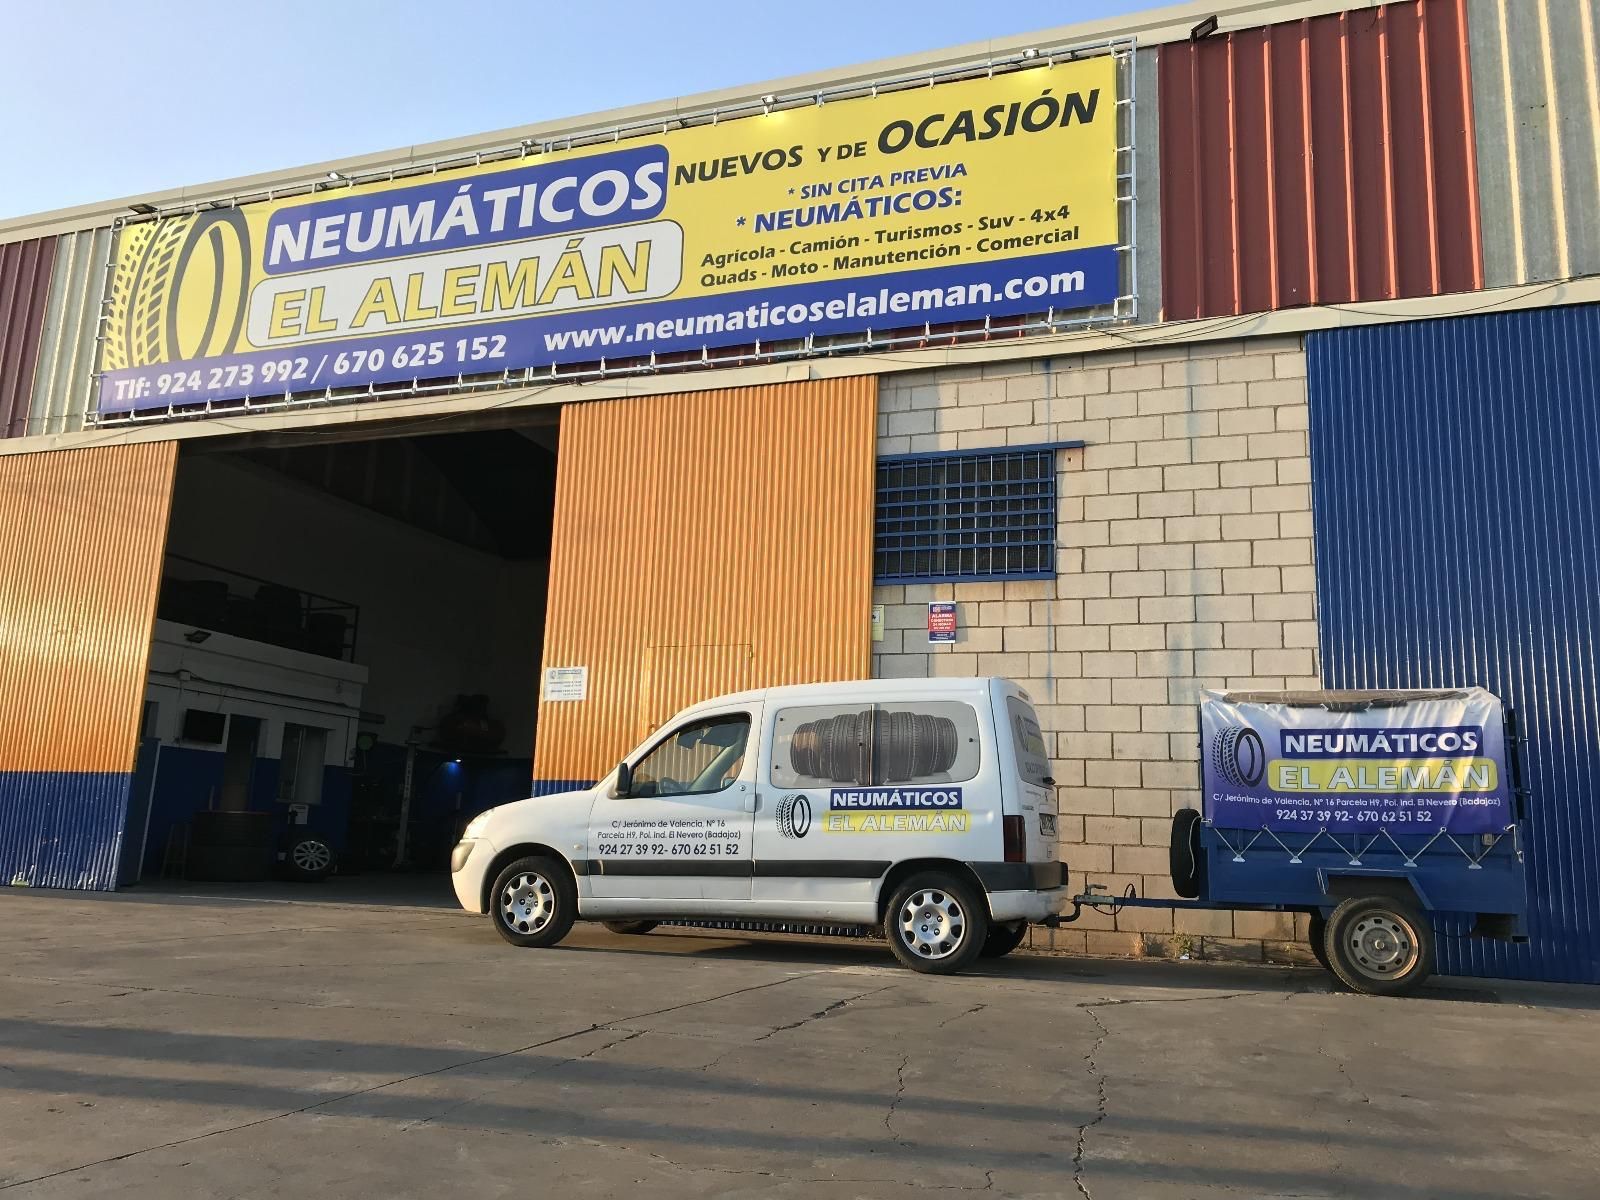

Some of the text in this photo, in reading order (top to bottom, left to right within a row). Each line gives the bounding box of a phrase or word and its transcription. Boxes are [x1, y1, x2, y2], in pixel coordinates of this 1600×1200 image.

[674, 87, 1101, 186] NUEVOS Y DE OCASIÓN
[801, 163, 967, 199] SIN CITA PREVIA
[269, 160, 664, 266] NEUMÁTICOS
[754, 186, 962, 233] NEUMÁTICOS:
[701, 245, 775, 268] Agrícola
[790, 235, 859, 255] Camión
[874, 221, 962, 244] Turismos
[978, 216, 1014, 231] Suv
[1030, 205, 1070, 223] 4x4
[701, 269, 757, 287] Quads
[771, 262, 818, 278] Moto
[833, 244, 960, 270] Manutención
[976, 226, 1079, 253] Comercial
[268, 238, 653, 340] EL ALEMÁN
[544, 270, 1085, 352] www.neumaticoselaleman.com
[115, 376, 151, 400] Tlf:
[157, 370, 201, 395] 924
[208, 364, 254, 390] 273
[261, 357, 309, 383] 992
[334, 348, 385, 375] 670
[392, 341, 445, 369] 625
[456, 335, 507, 362] 152
[1285, 730, 1478, 753] NEUMÁTICOS
[1278, 759, 1490, 790] EL ALEMÁN
[833, 789, 958, 807] NEUMÁTICOS
[1225, 794, 1260, 804] Jerónimo
[1325, 798, 1335, 806] 16
[1337, 798, 1367, 806] Parcela
[1417, 798, 1425, 806] El
[1426, 798, 1457, 806] Nevero
[1460, 797, 1501, 807] (Badajoz)
[622, 820, 656, 828] Jerónimo
[657, 820, 668, 828] de
[717, 819, 725, 828] 16
[828, 811, 966, 832] EL ALEMÁN
[1276, 809, 1298, 821] 924
[1300, 810, 1313, 821] 37
[1317, 811, 1331, 821] 39
[1357, 811, 1379, 822] 670
[1381, 811, 1396, 822] 62
[1399, 811, 1412, 822] 51
[1416, 811, 1432, 822] 52
[597, 831, 625, 839] Parcela
[668, 831, 675, 839] El
[676, 831, 704, 839] Nevero
[704, 830, 741, 840] (Badajoz)
[599, 844, 617, 855] 924
[620, 844, 633, 855] 27
[635, 844, 649, 855] 39
[671, 844, 691, 855] 670
[693, 844, 707, 855] 62
[709, 844, 721, 855] 51
[725, 844, 739, 855] 52
